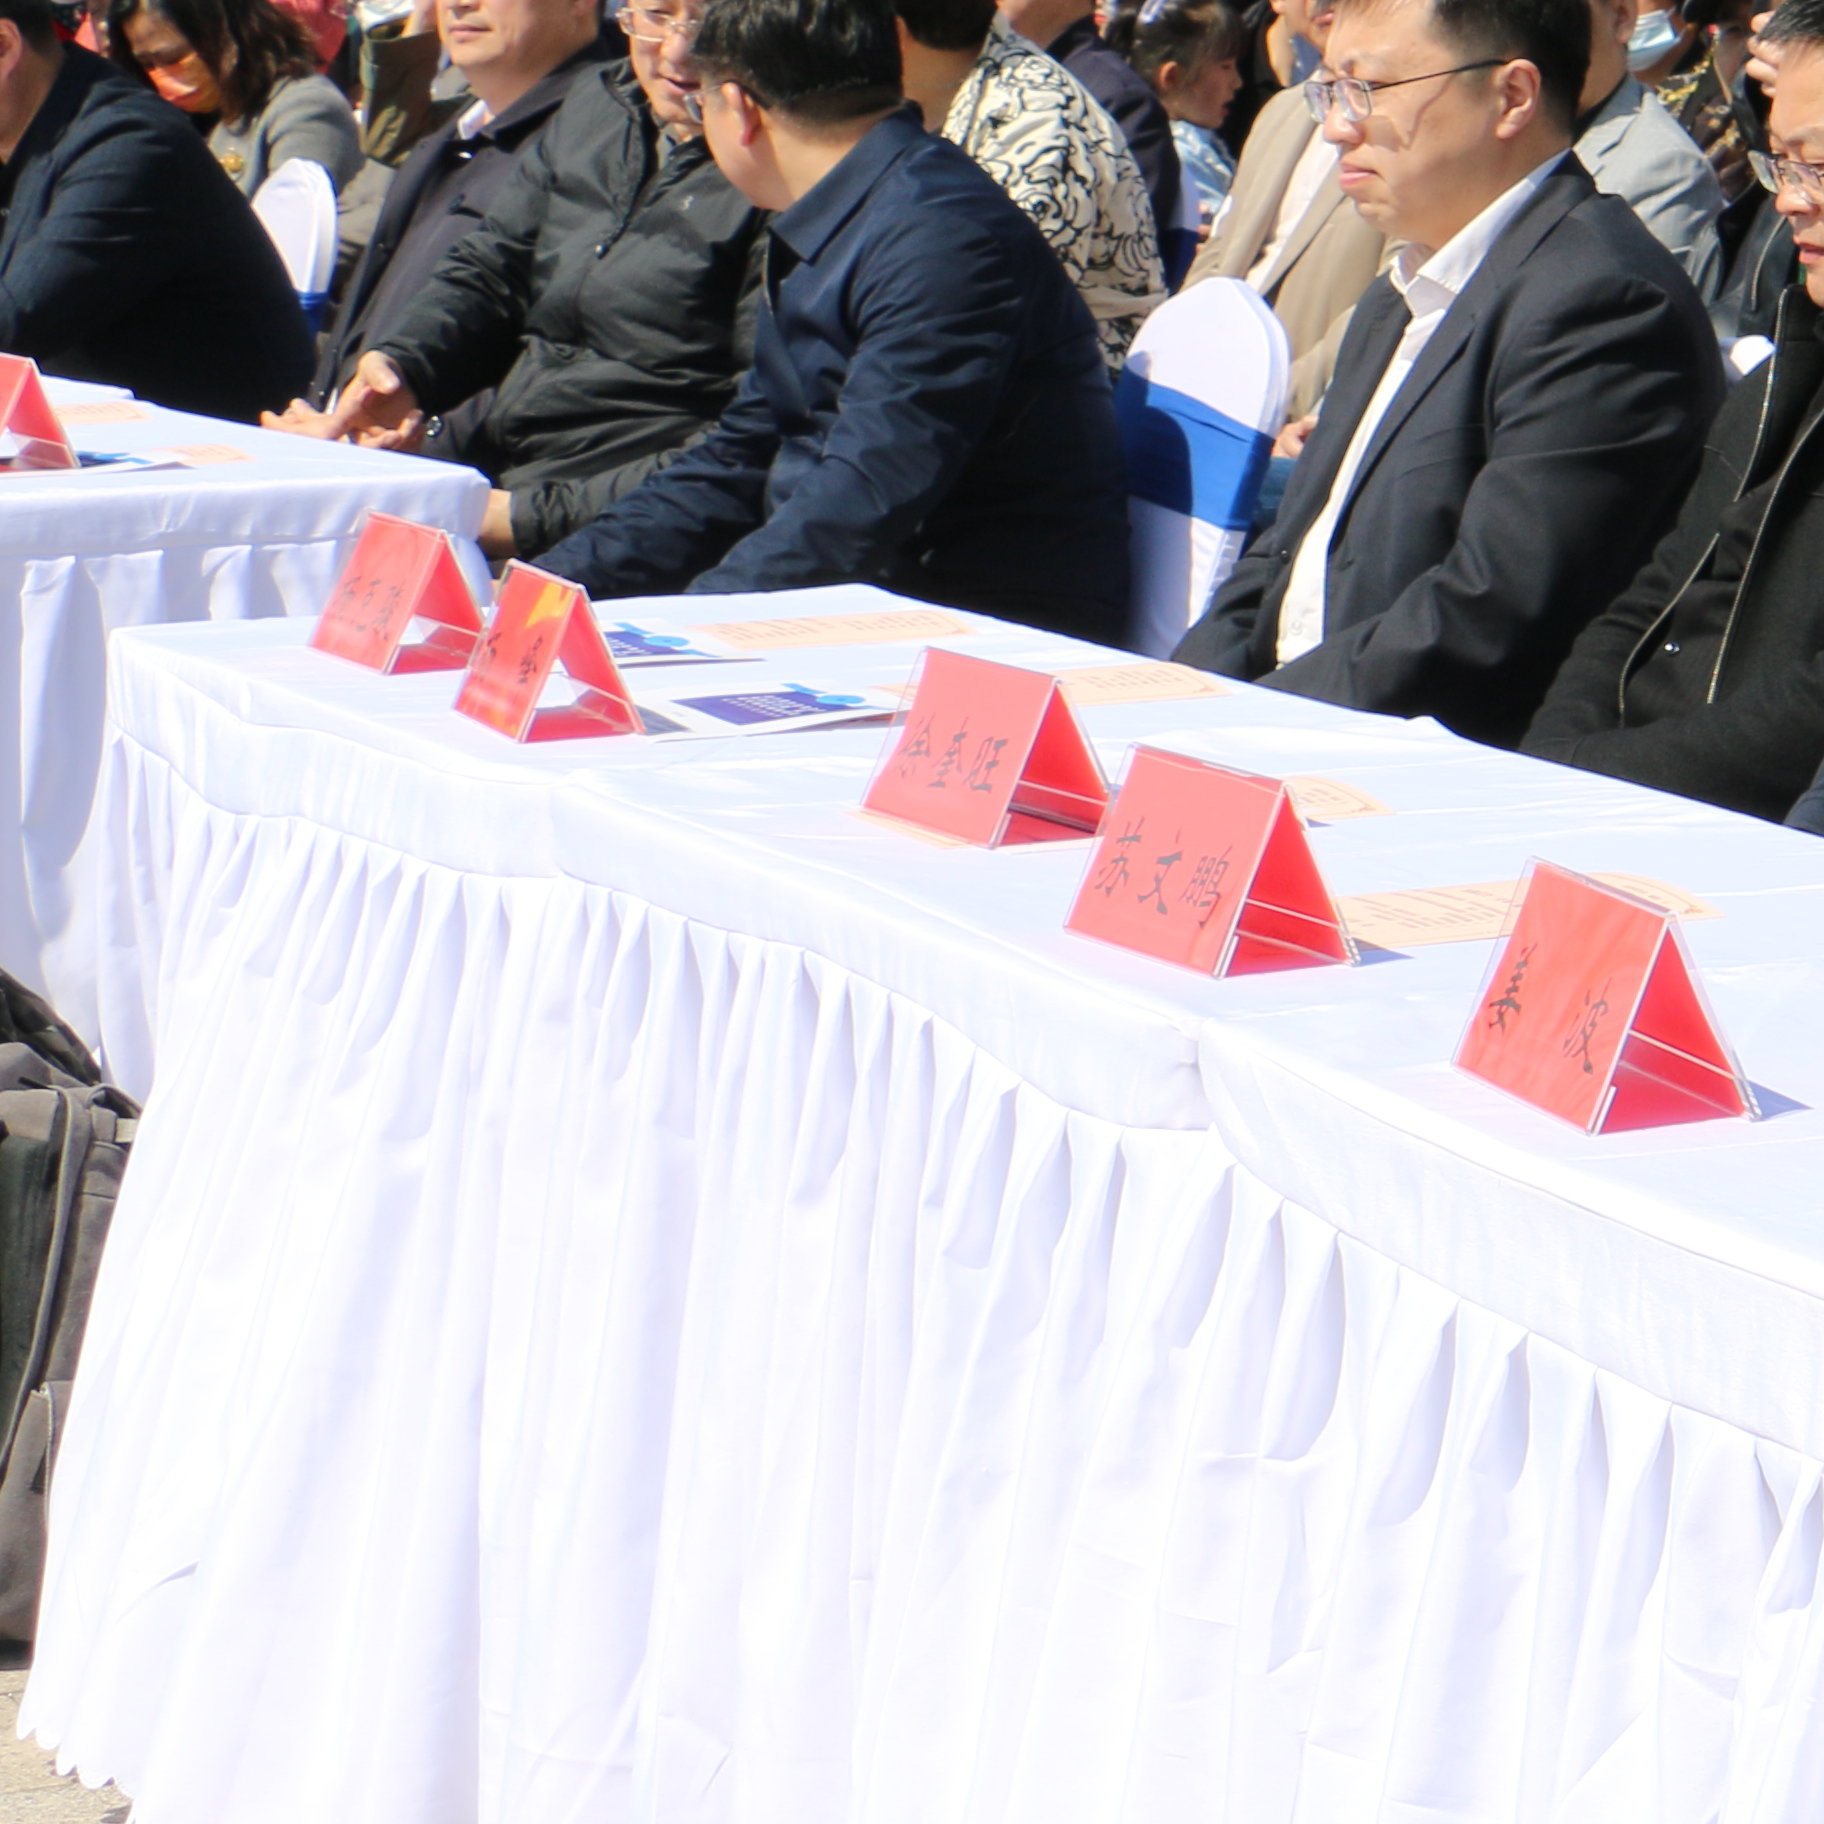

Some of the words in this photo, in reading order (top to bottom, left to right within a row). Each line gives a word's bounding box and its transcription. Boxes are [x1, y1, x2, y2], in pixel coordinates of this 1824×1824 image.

[1094, 816, 1233, 928] 苏文鹏
[1487, 942, 1614, 1075] 姜波
